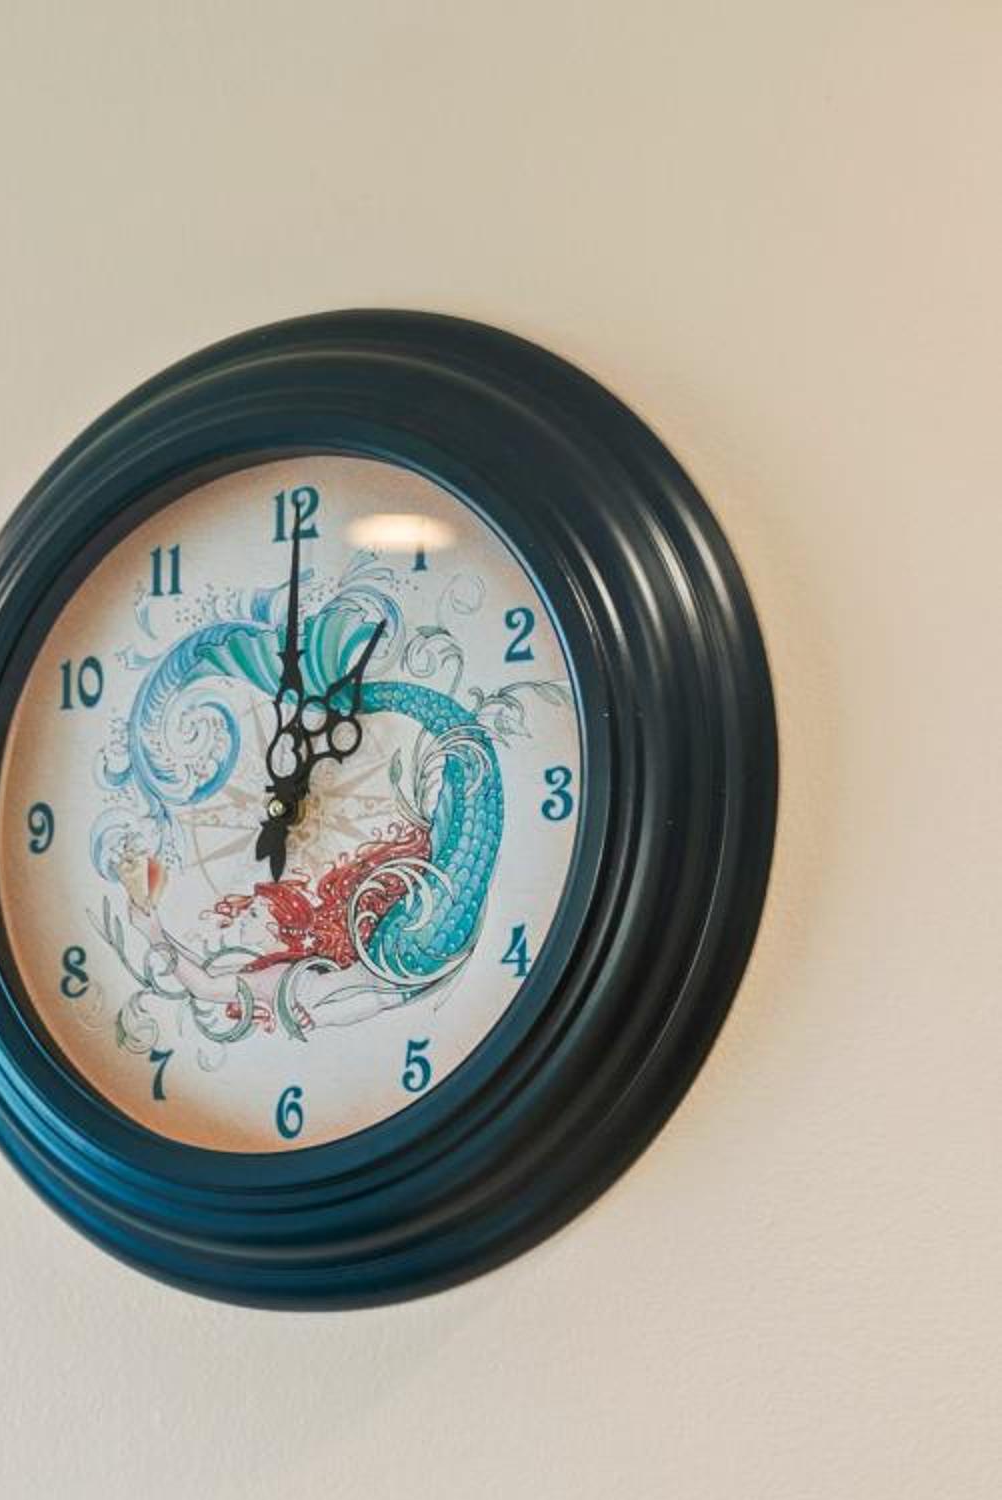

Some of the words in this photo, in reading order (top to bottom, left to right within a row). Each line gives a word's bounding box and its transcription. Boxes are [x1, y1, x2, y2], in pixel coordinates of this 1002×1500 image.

[274, 487, 319, 543] 12
[150, 545, 182, 596] 11
[505, 608, 535, 662] 2
[60, 656, 104, 710] 10
[542, 766, 574, 821] 3
[27, 803, 55, 854] 9
[60, 946, 88, 998] 8
[501, 924, 532, 978] 4
[149, 1049, 173, 1101] 7
[402, 1039, 432, 1094] 5
[276, 1086, 304, 1140] 6
